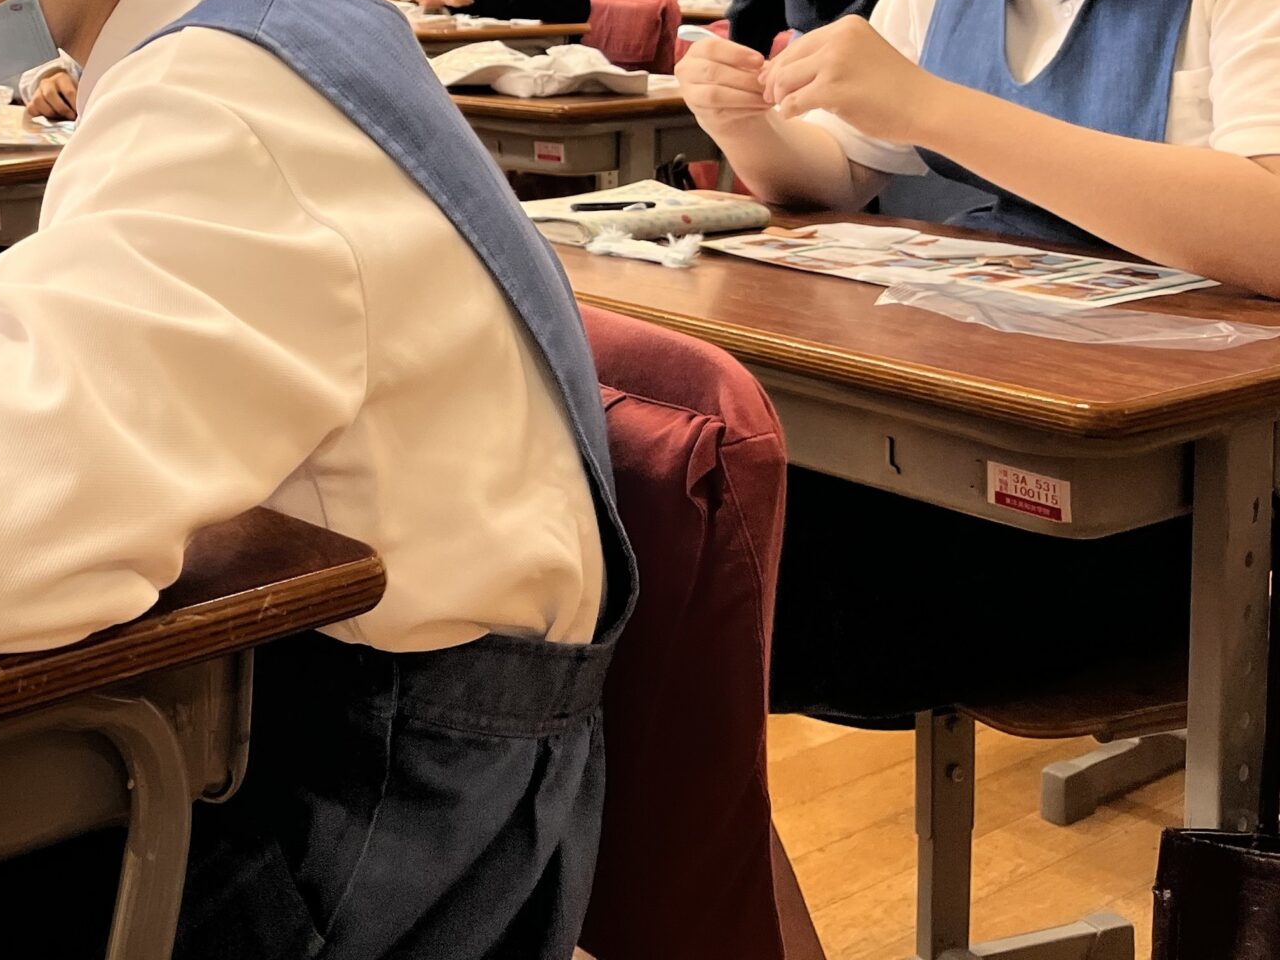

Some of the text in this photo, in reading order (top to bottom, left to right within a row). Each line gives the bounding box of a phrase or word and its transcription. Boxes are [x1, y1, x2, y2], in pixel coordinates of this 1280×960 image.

[1012, 473, 1028, 486] 3A
[1035, 479, 1057, 494] 531
[1013, 484, 1059, 506] 100115
